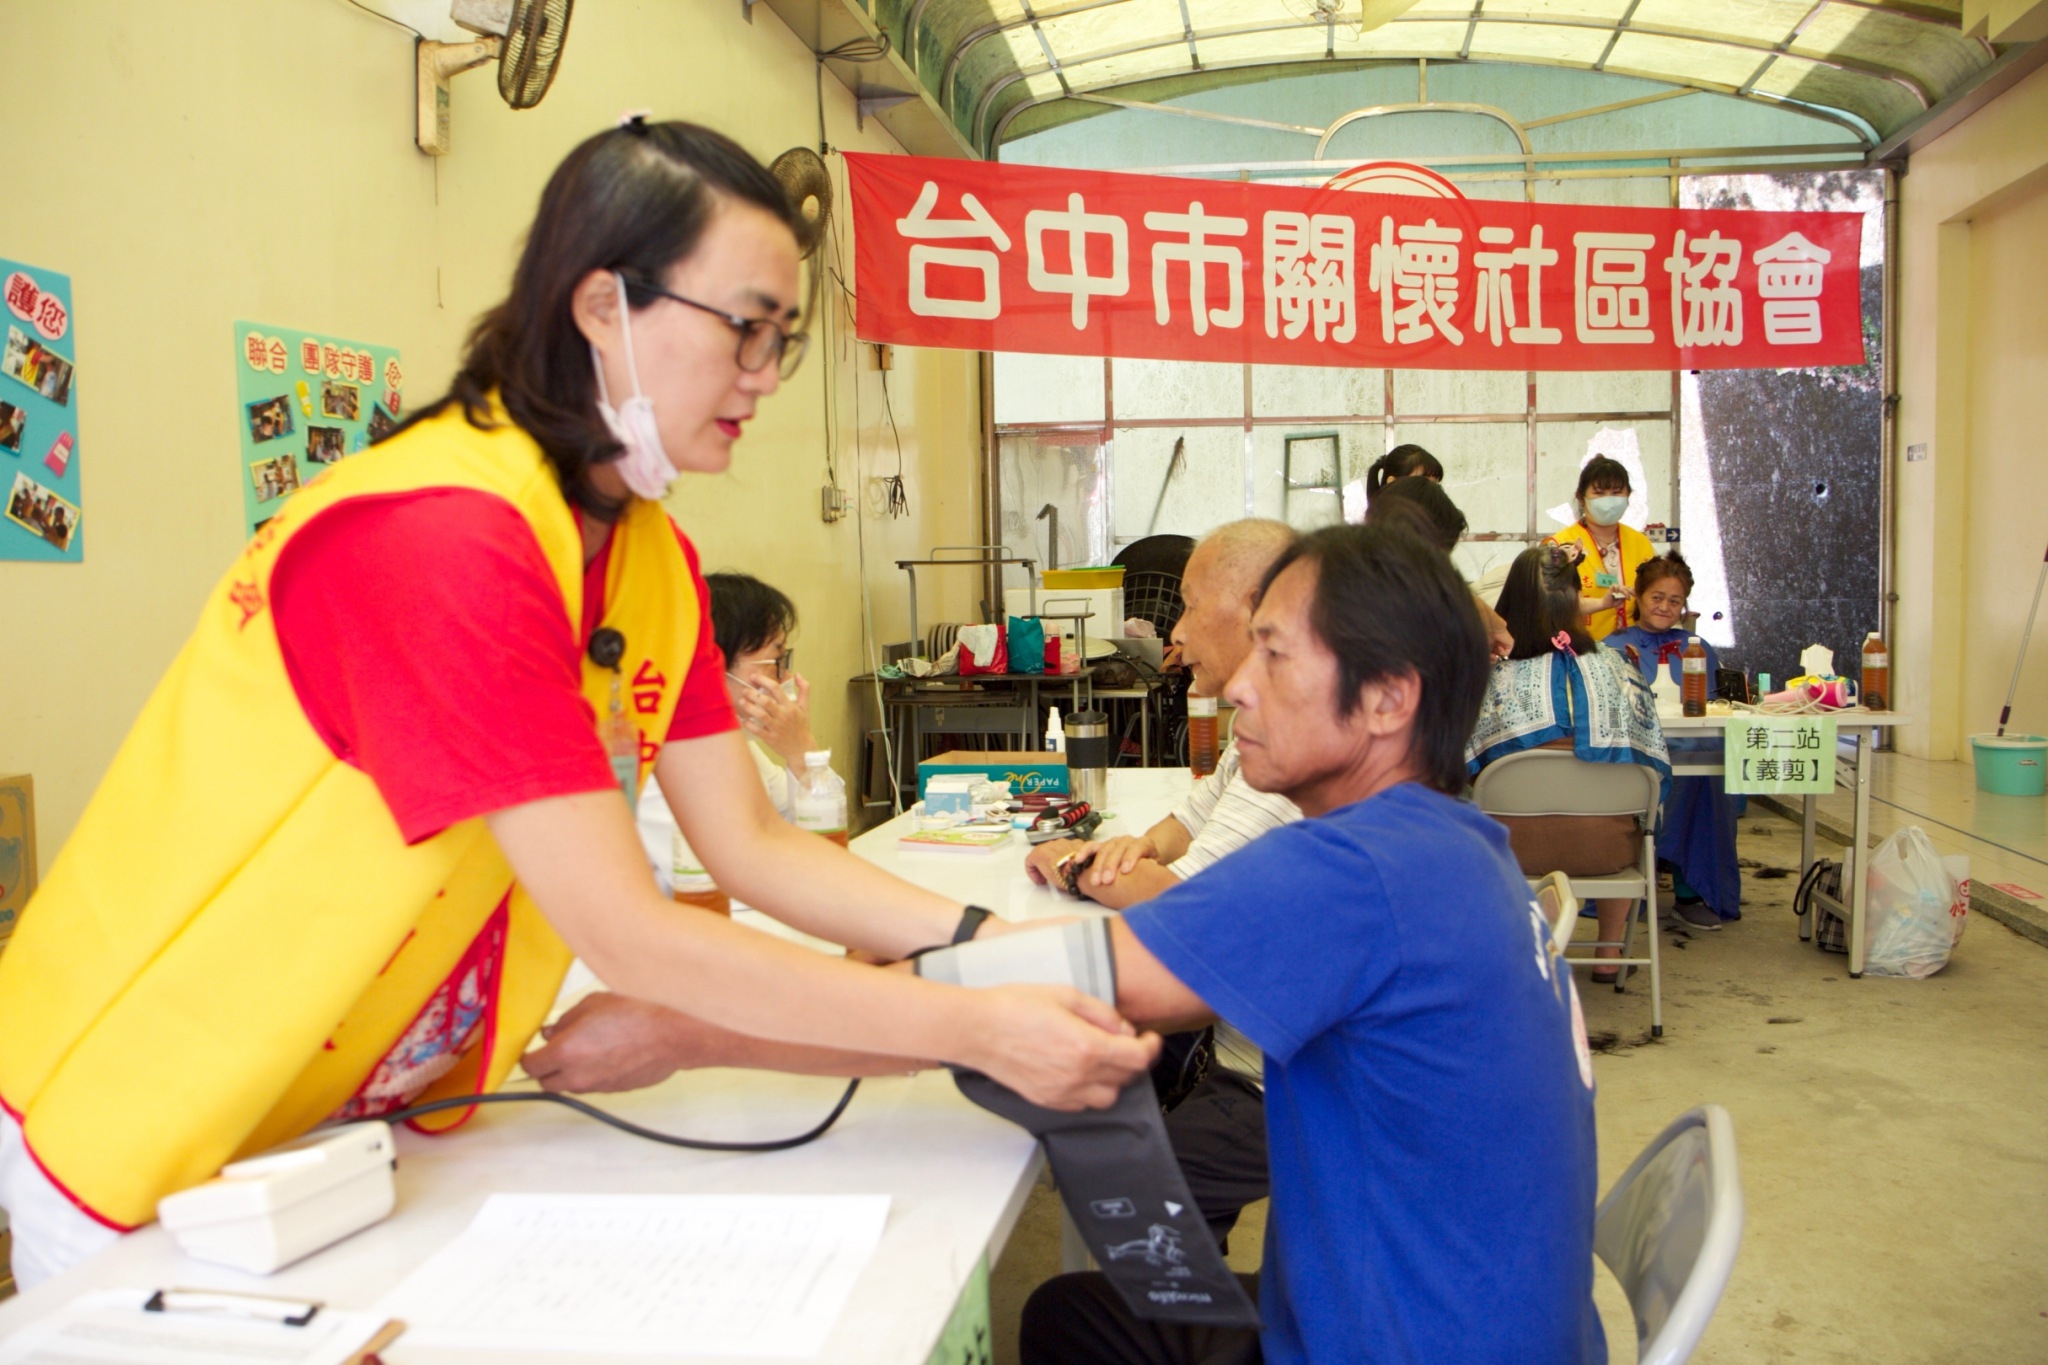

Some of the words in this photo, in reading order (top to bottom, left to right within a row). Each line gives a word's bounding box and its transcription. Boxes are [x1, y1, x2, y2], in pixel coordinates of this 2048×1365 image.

[896, 180, 1831, 348] 台中市關懷社區協會
[8, 273, 66, 337] 護您
[247, 336, 288, 371] 聯合
[303, 343, 373, 381] 團隊守護
[1746, 726, 1820, 750] 第二站
[1027, 778, 1059, 786] PAPER
